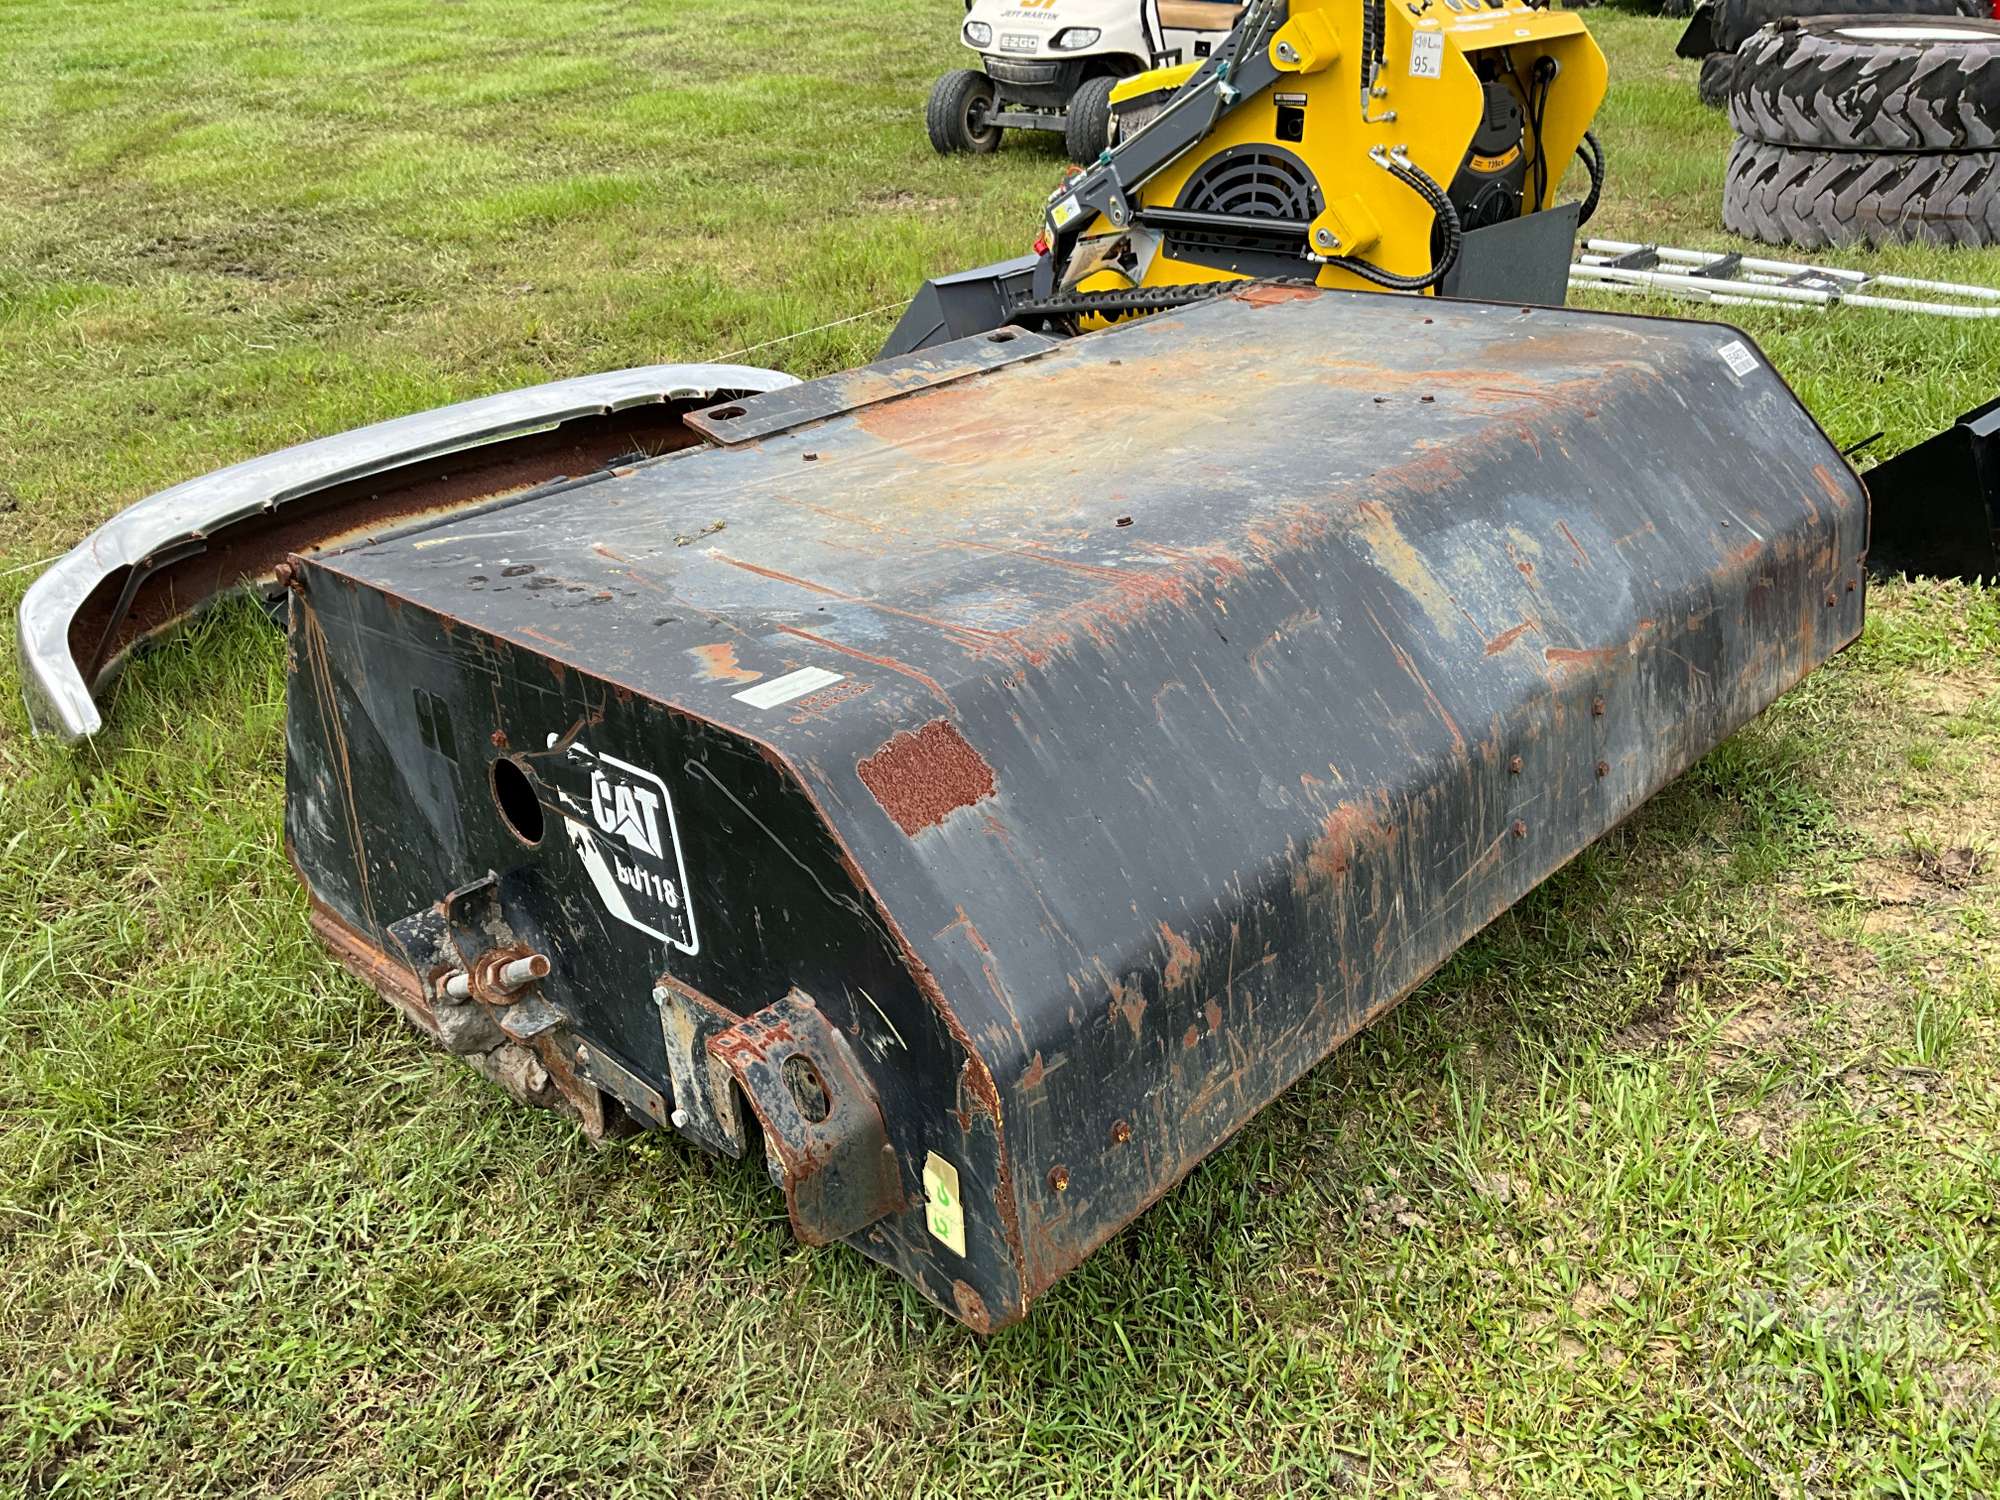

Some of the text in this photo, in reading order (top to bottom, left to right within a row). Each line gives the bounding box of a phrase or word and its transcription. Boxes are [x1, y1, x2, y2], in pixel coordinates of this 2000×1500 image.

[1001, 9, 1058, 20] JEFF MARTIN
[1001, 36, 1038, 48] EZGO
[1413, 55, 1428, 73] 95
[590, 770, 663, 860] CAT
